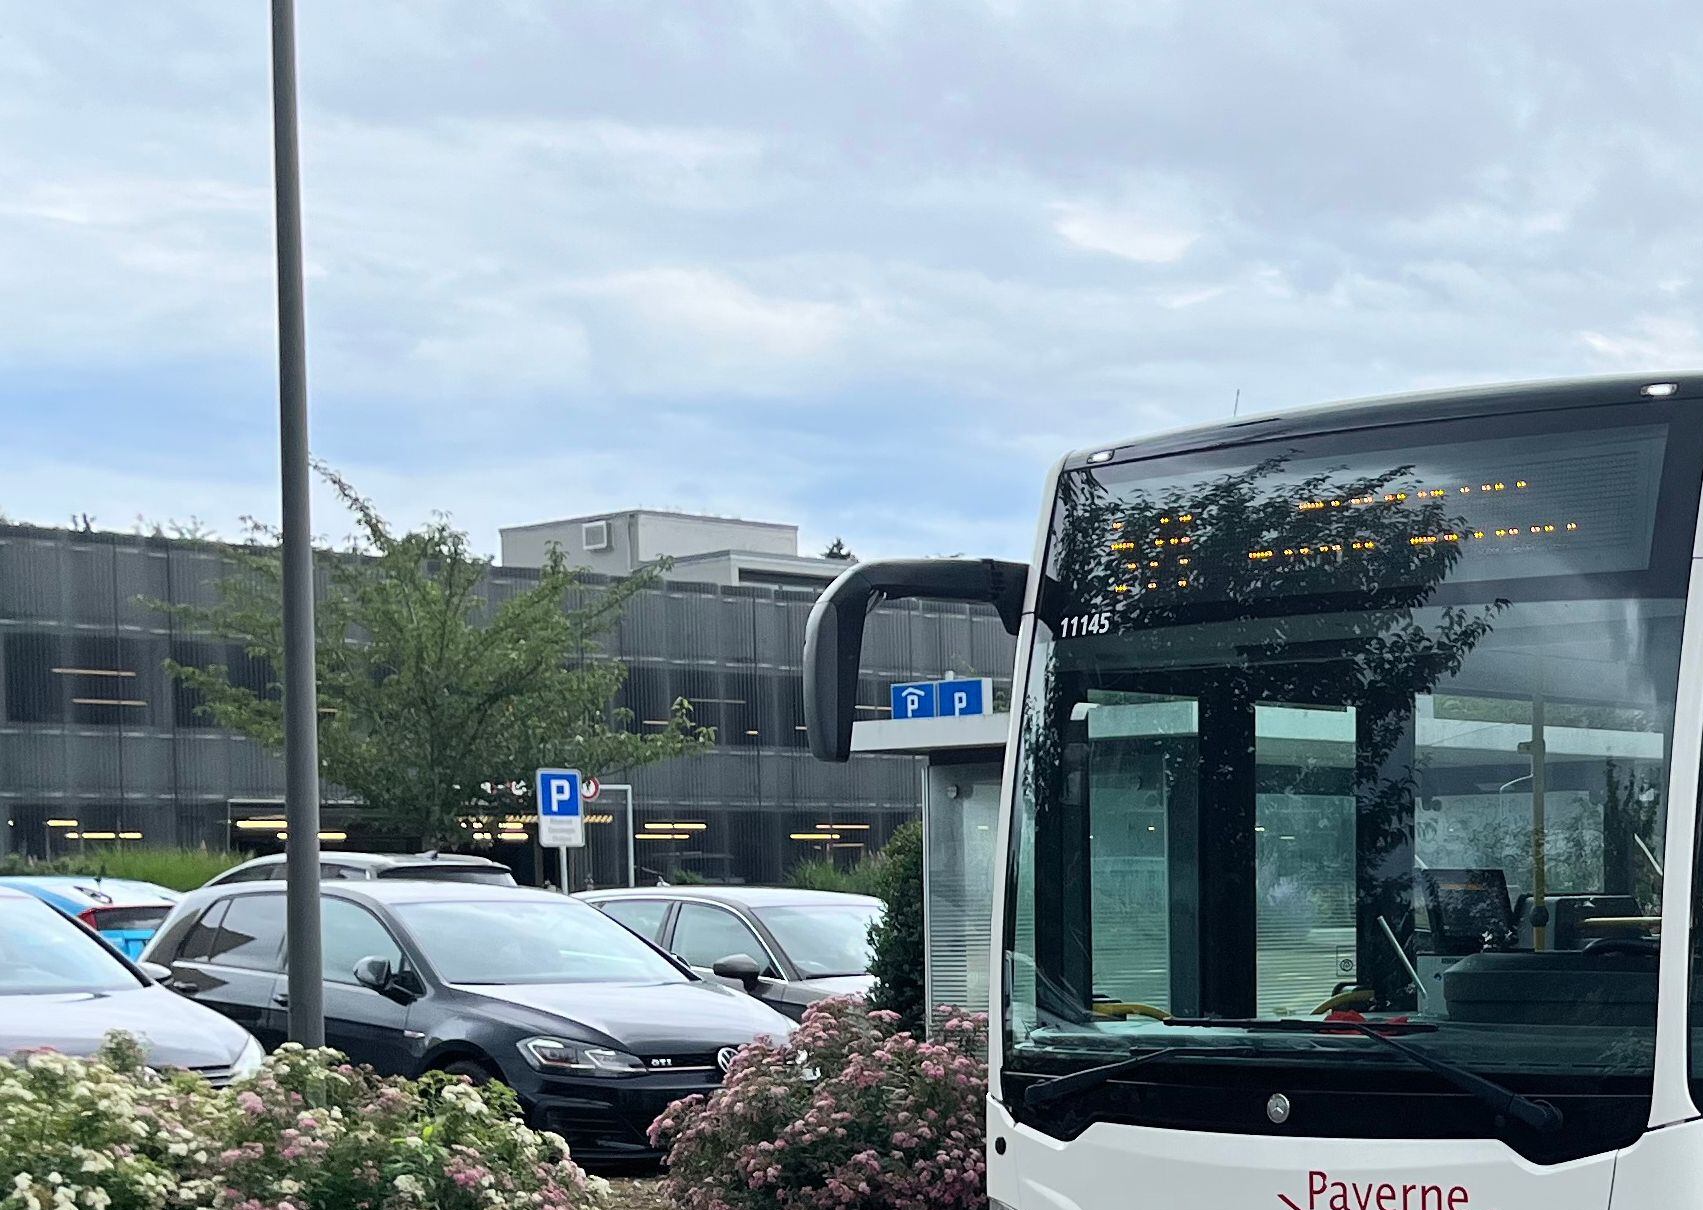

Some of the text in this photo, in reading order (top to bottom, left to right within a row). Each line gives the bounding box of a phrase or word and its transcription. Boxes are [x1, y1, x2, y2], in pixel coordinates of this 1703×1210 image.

[1061, 612, 1110, 638] 11145
[907, 695, 919, 717] P
[953, 691, 967, 717] P
[550, 779, 571, 812] P
[651, 1058, 673, 1067] GTI
